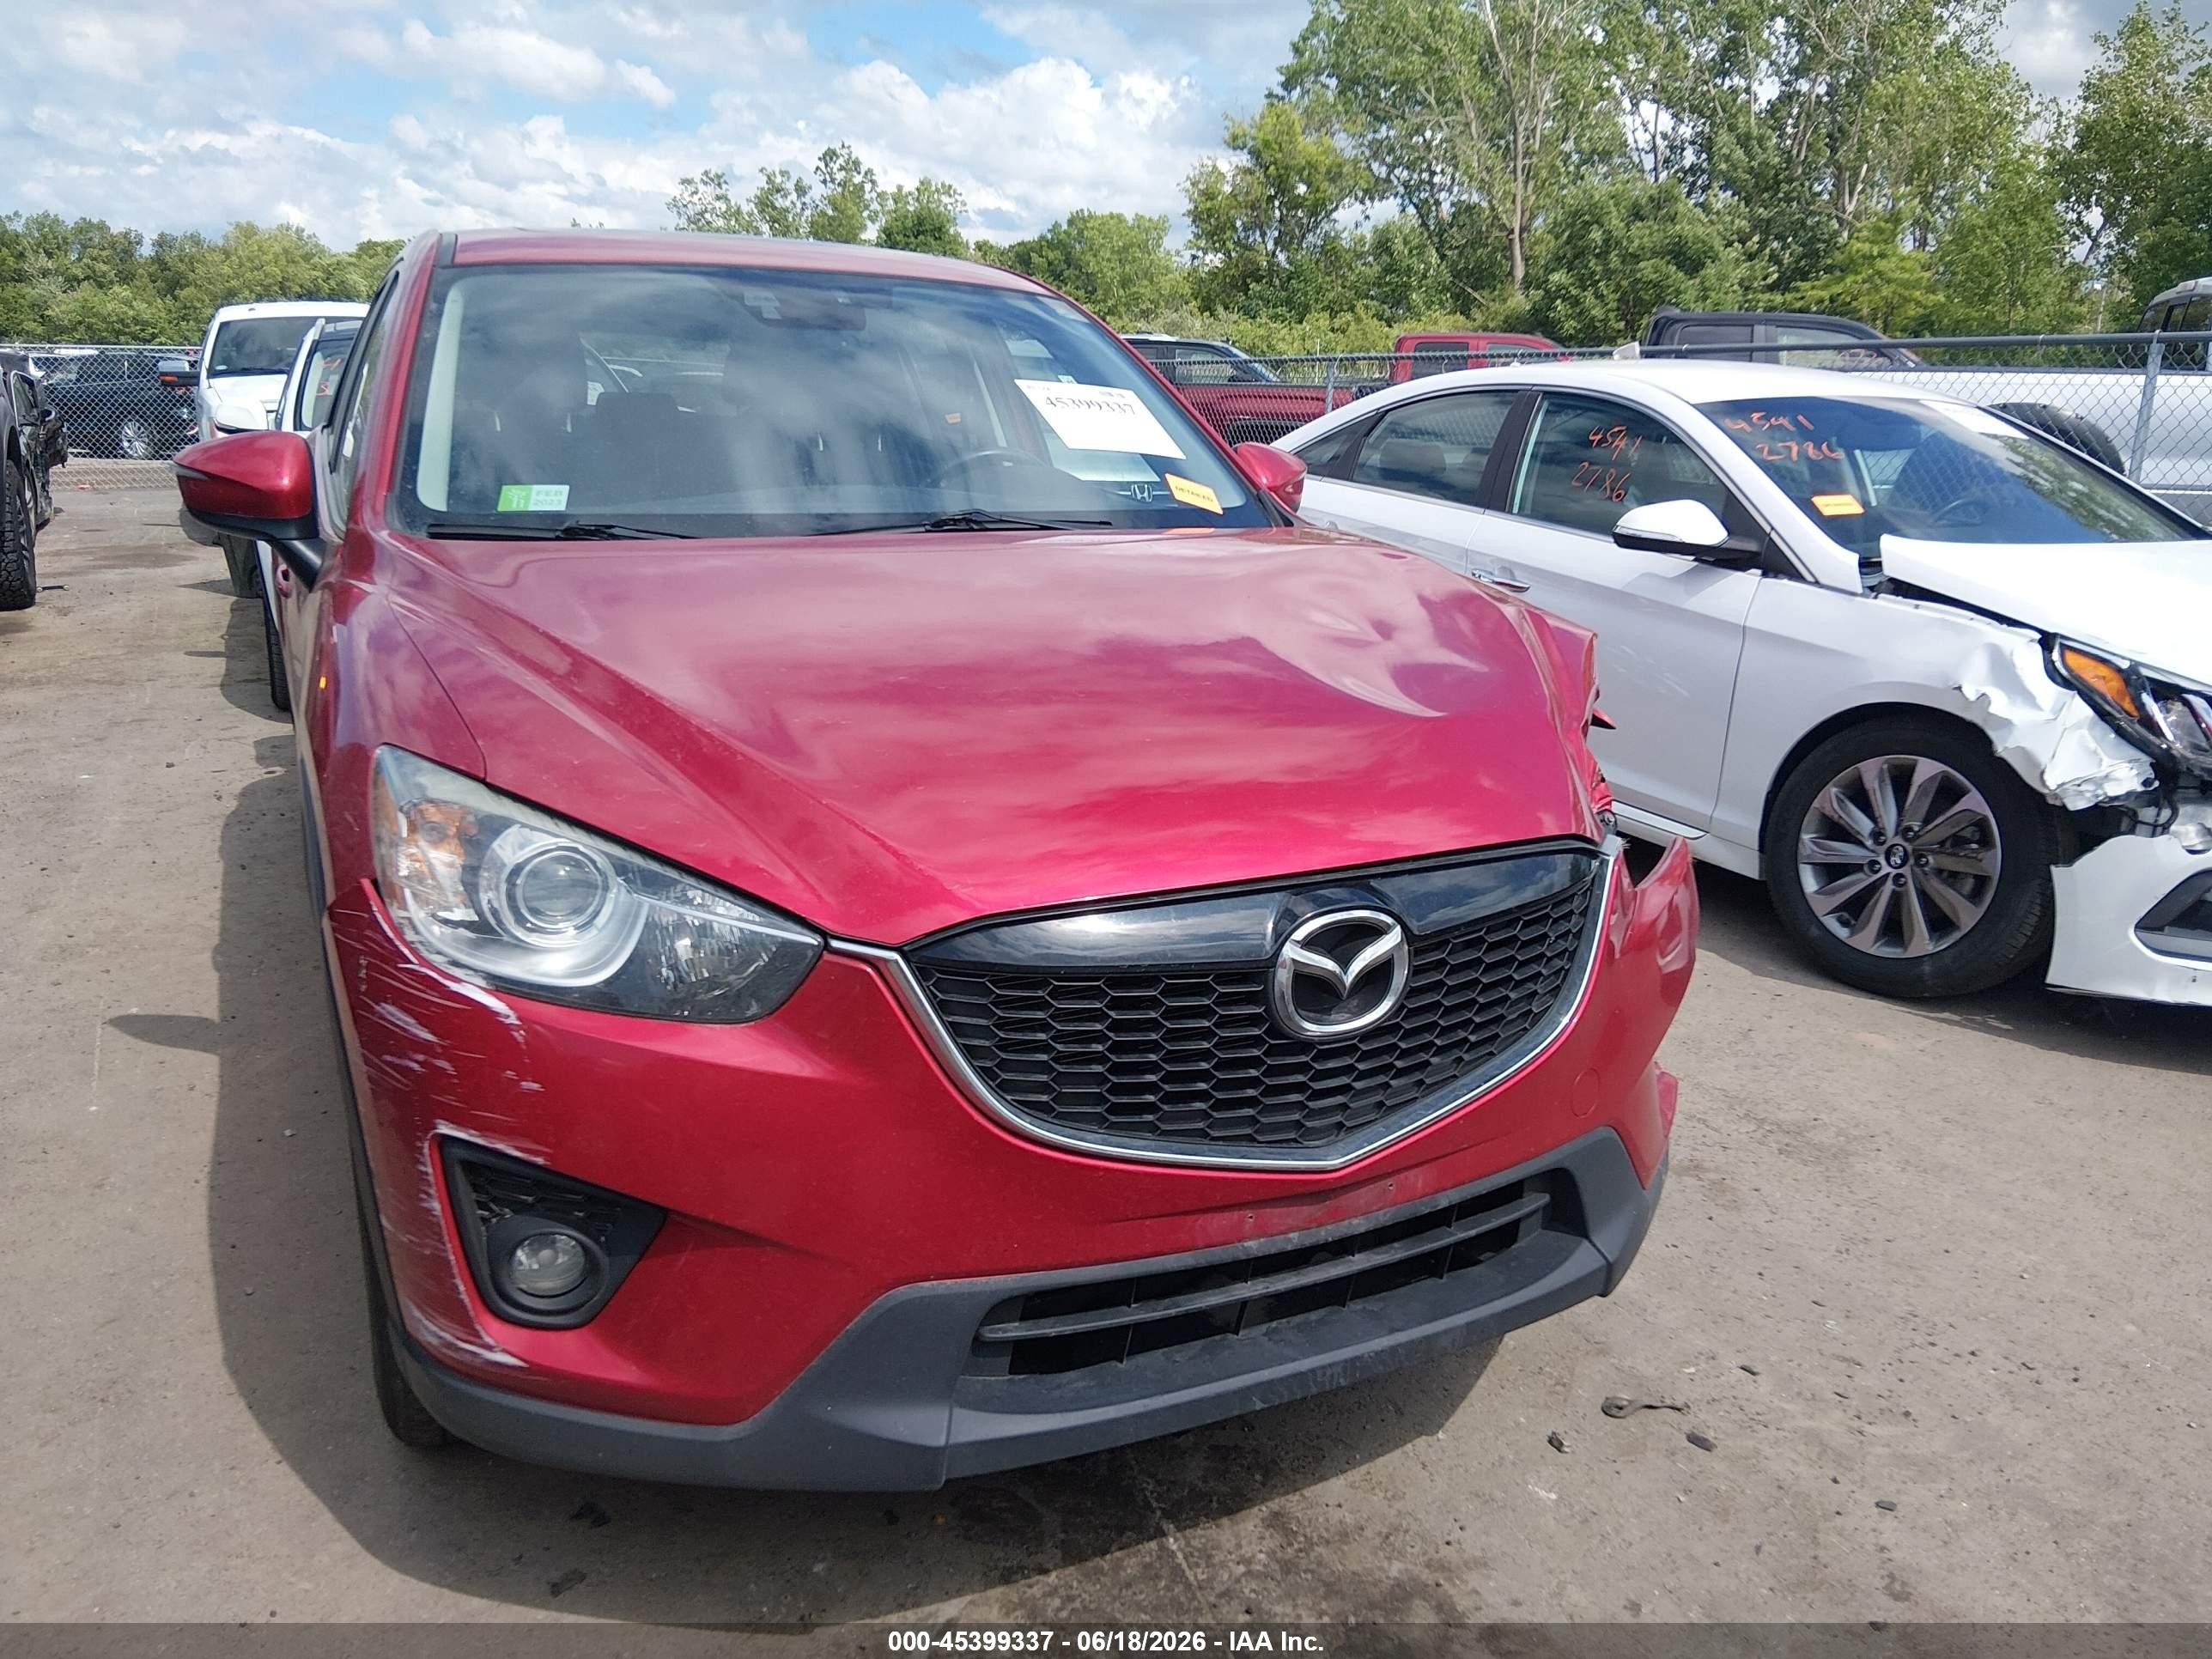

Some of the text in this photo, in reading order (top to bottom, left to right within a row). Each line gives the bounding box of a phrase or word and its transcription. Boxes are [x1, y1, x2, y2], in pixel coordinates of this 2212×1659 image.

[1045, 396, 1136, 416] 45399337
[1755, 441, 1845, 462] 2786
[1571, 461, 1631, 502] 2786
